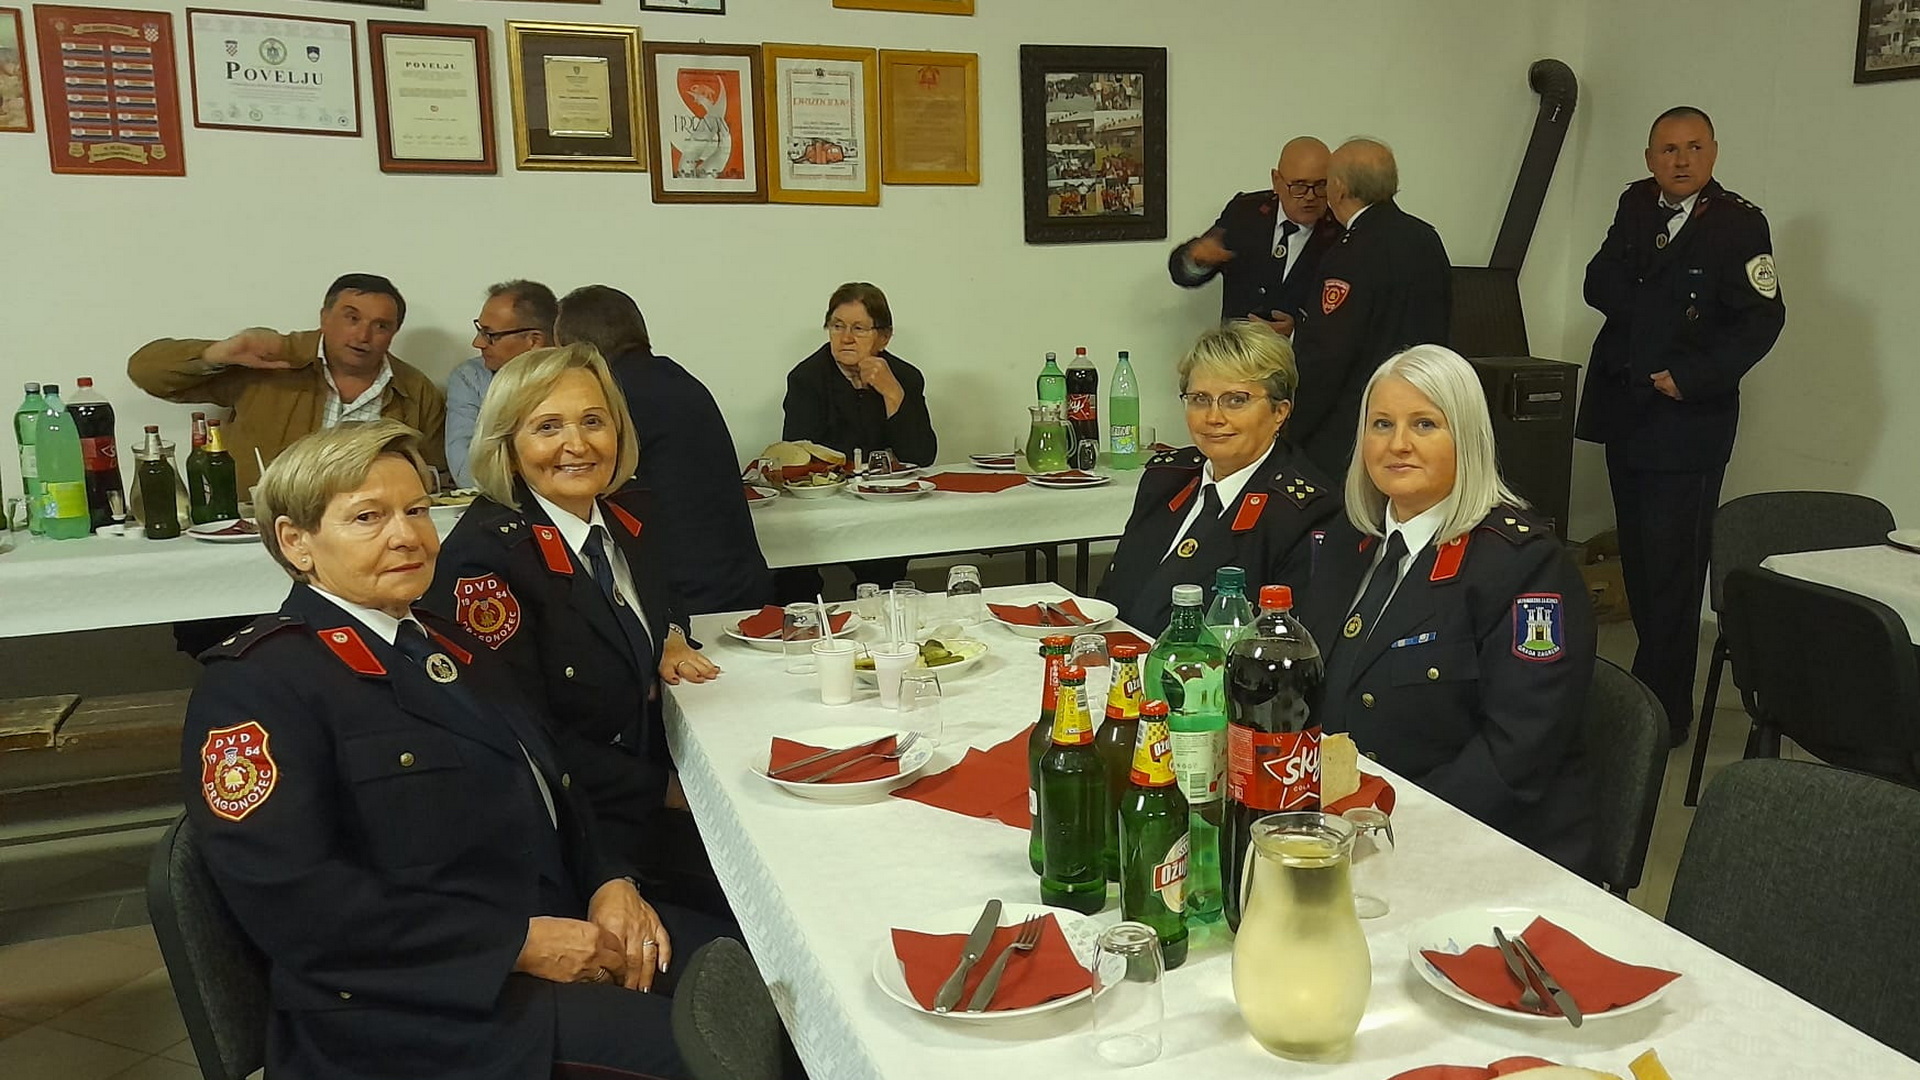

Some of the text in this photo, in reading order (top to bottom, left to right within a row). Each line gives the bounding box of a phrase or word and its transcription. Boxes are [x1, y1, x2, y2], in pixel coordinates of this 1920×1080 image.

[225, 61, 323, 86] POVELJU
[464, 579, 498, 595] DVD
[215, 733, 251, 749] DVD
[244, 746, 261, 757] 54
[206, 753, 217, 765] 19
[1293, 783, 1311, 792] COLA
